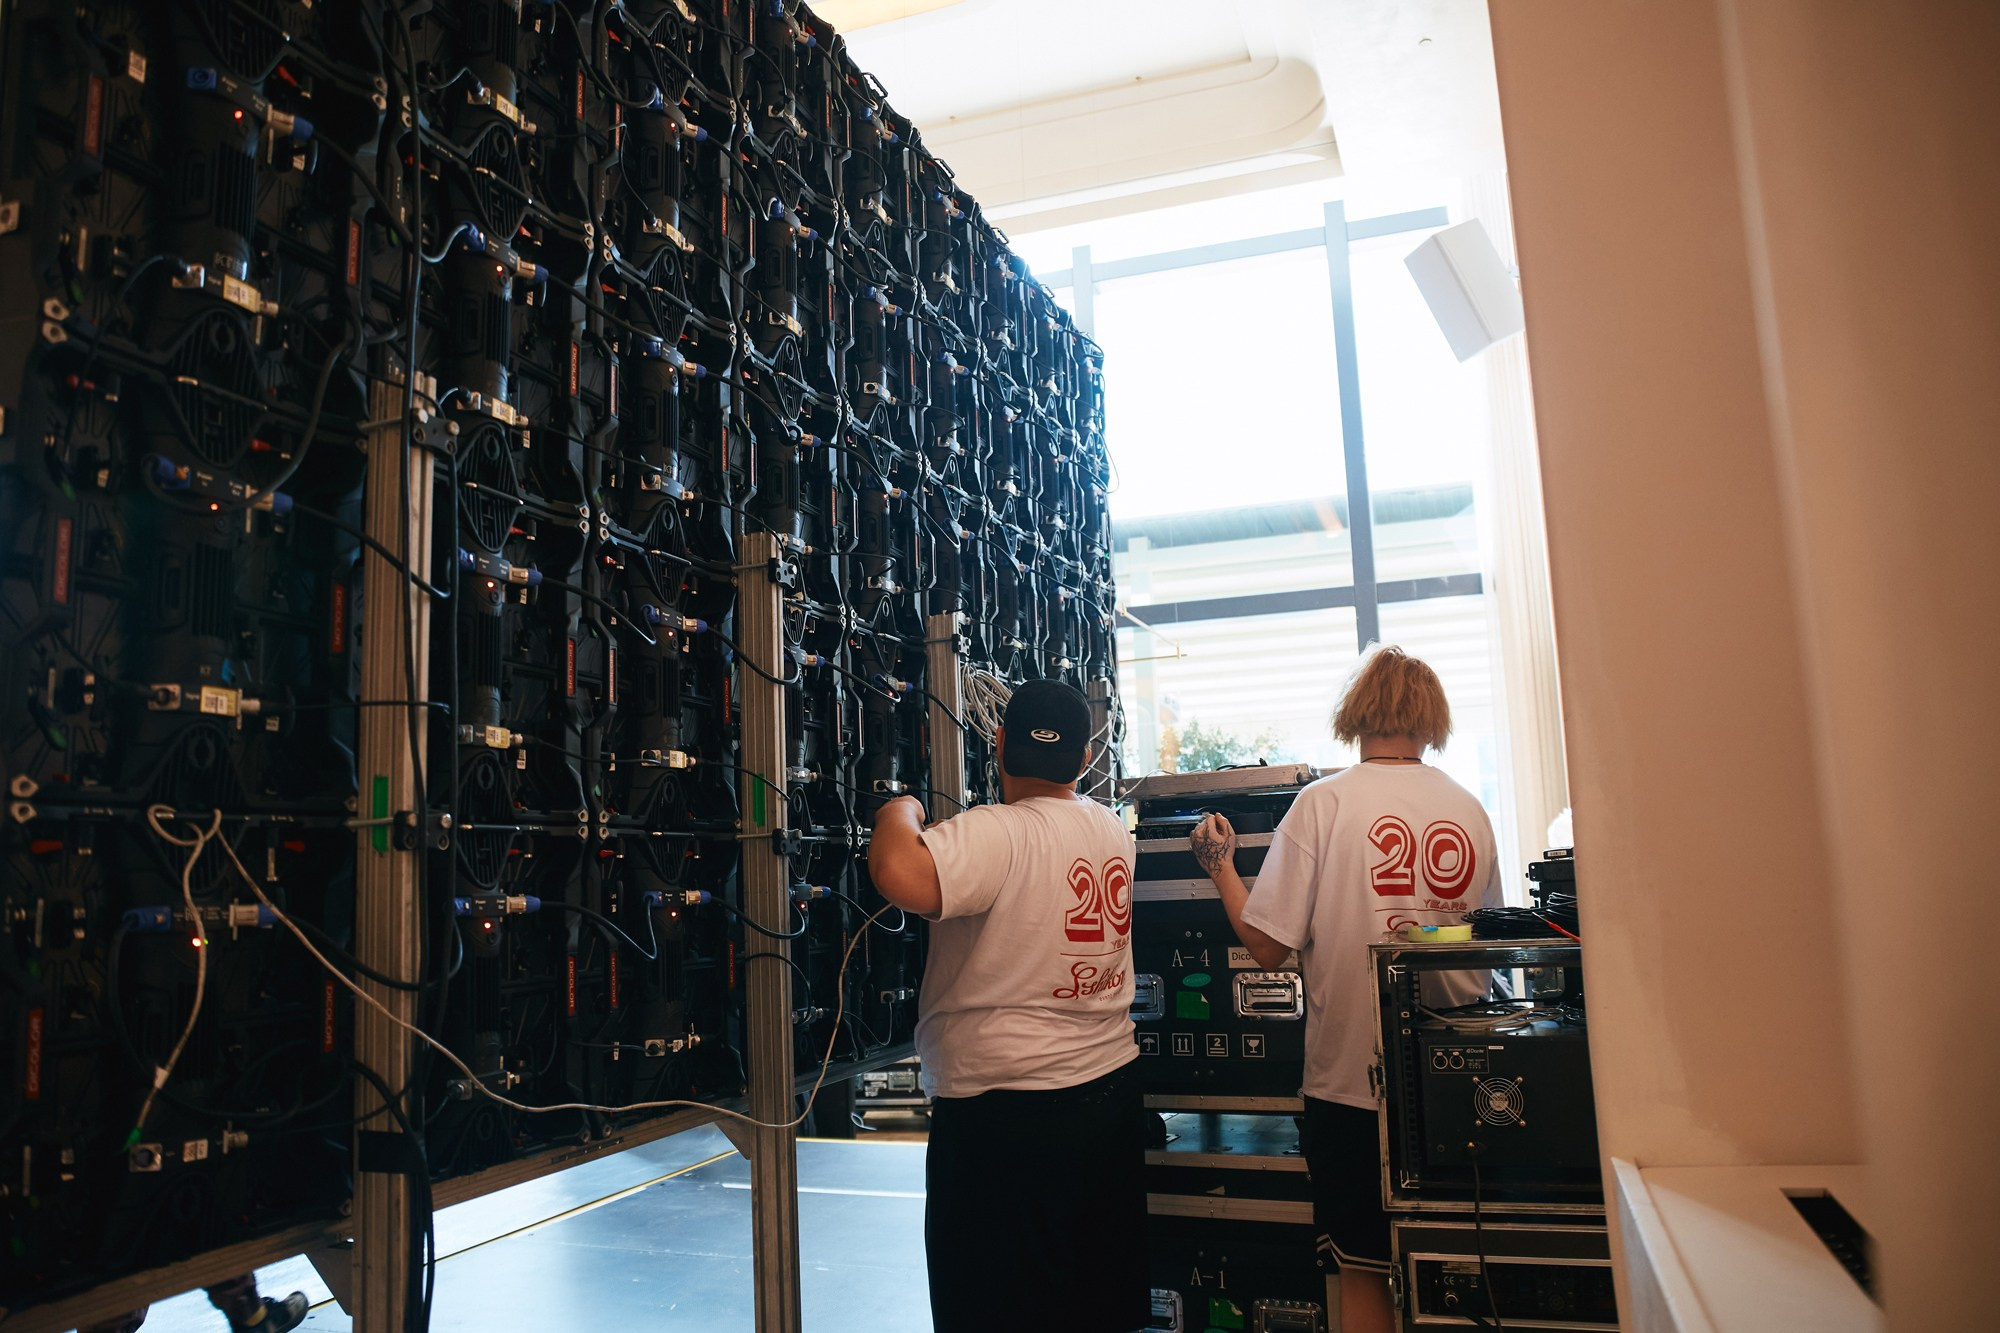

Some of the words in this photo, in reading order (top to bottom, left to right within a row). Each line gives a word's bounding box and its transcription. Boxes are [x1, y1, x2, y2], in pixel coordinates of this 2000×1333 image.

[1368, 815, 1476, 900] 20
[1064, 856, 1132, 942] 20
[1423, 899, 1468, 911] YEARS
[1232, 952, 1254, 961] Dico
[325, 984, 333, 1045] DICOLOR
[28, 1016, 41, 1093] DICOLOR
[1190, 1266, 1227, 1290] A-1
